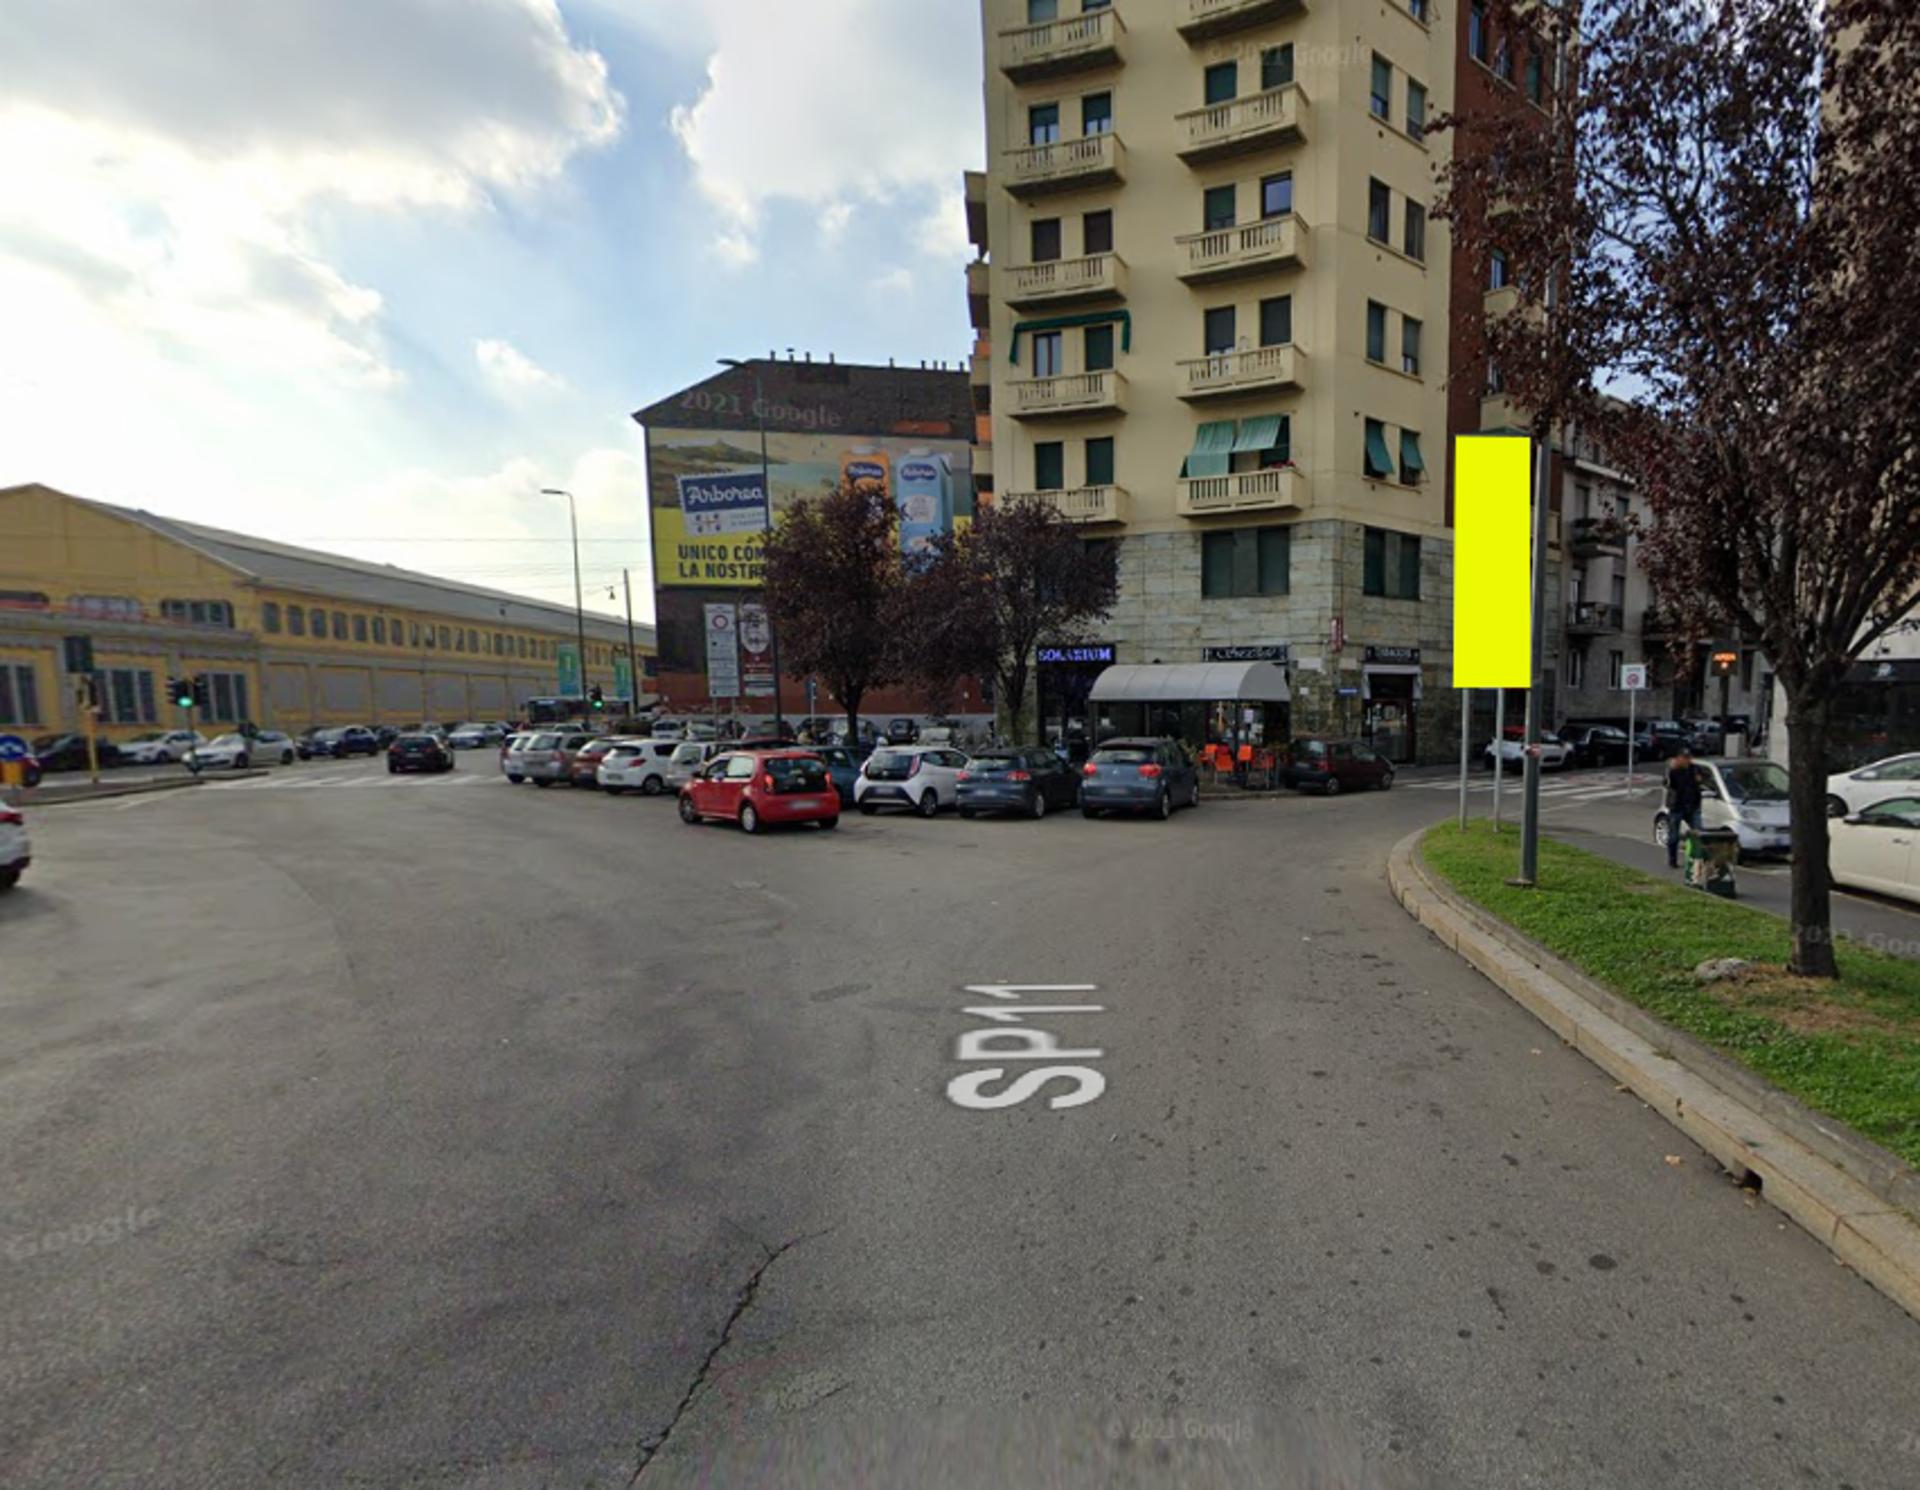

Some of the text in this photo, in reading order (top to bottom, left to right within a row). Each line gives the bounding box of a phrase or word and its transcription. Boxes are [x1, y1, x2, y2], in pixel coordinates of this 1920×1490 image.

[687, 484, 763, 505] Arborea
[677, 544, 728, 561] UNICO
[679, 562, 767, 579] LA NOSTR
